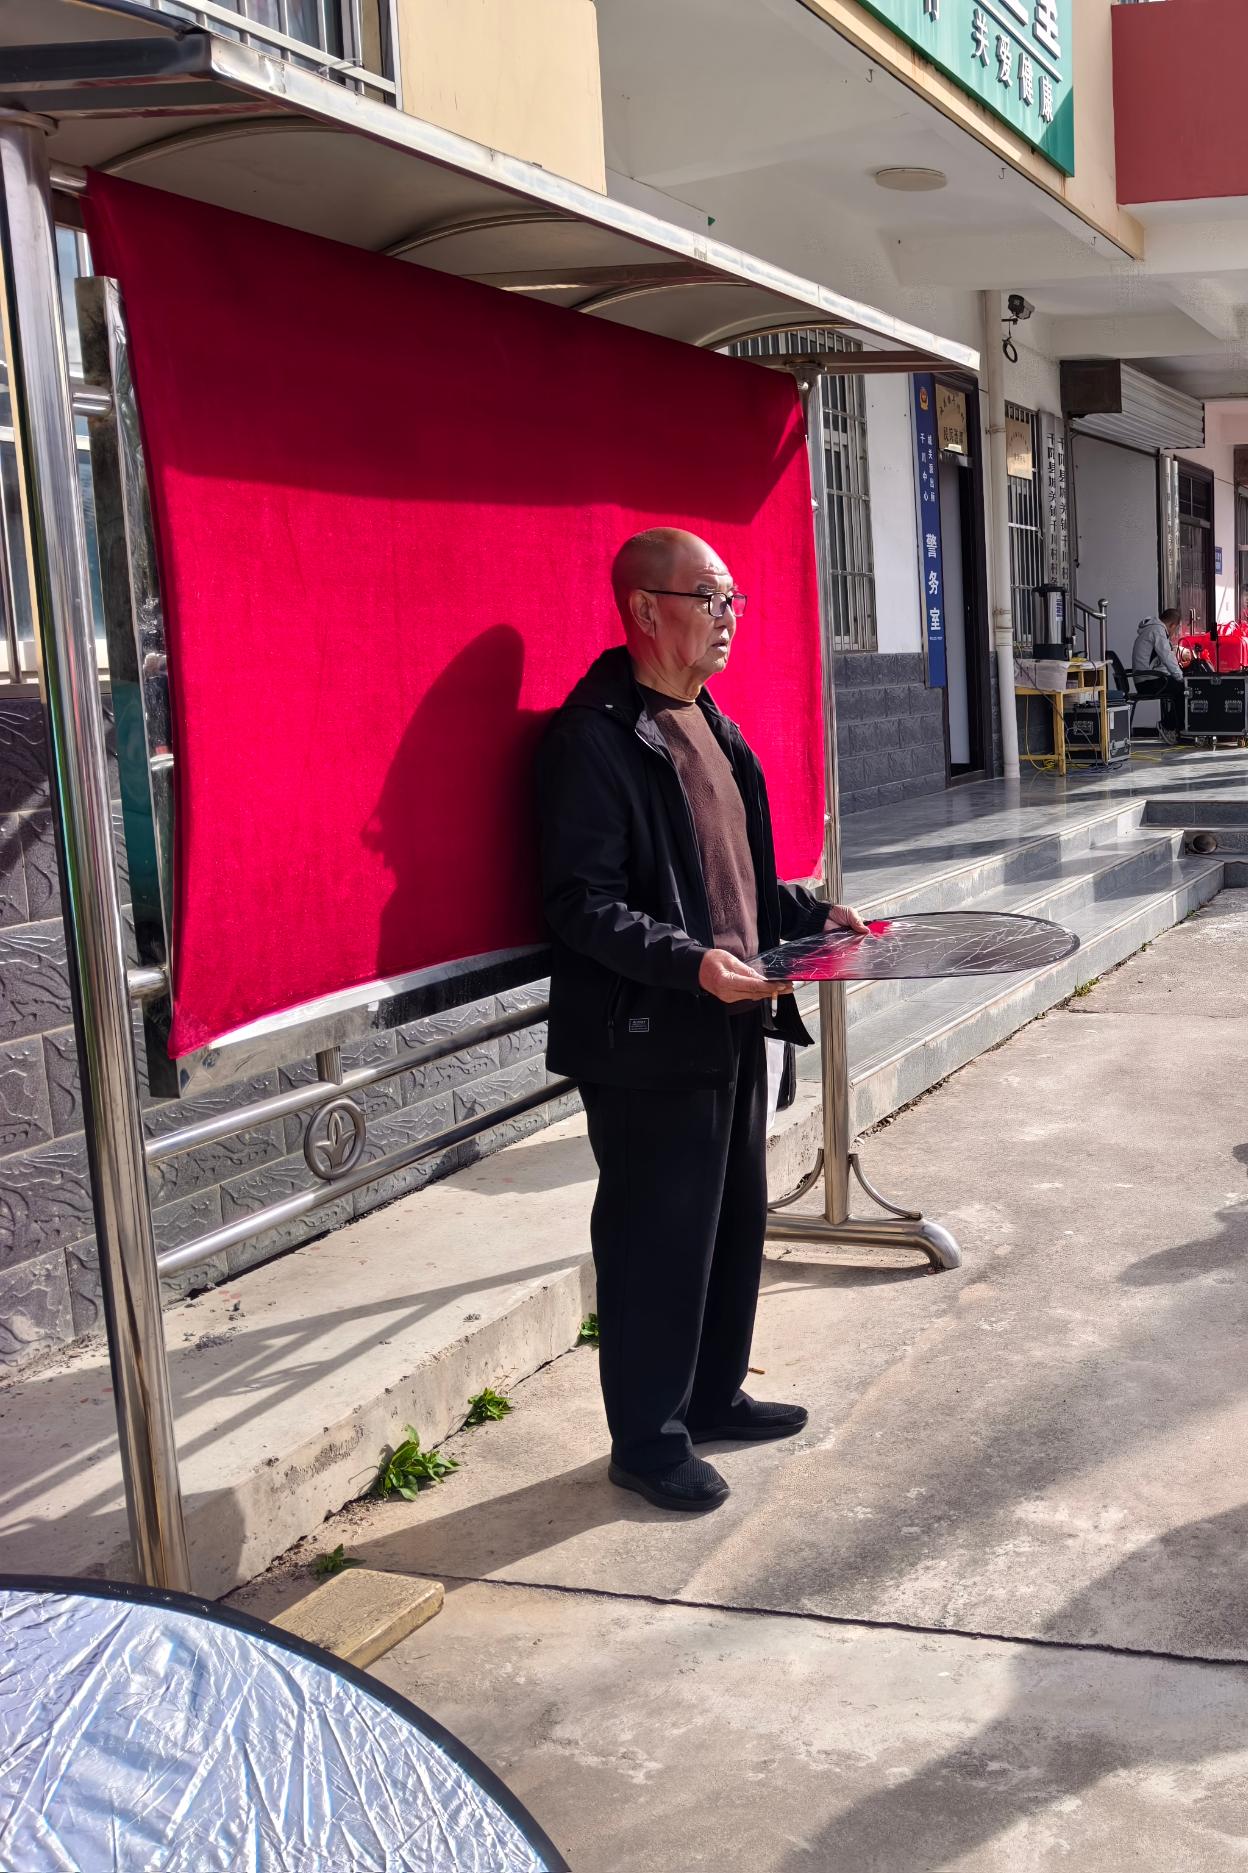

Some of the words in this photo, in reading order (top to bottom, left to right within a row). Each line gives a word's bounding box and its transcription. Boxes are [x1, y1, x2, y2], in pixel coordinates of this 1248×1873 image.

[971, 8, 1053, 123] 关爱健康
[926, 533, 941, 631] 警务室
